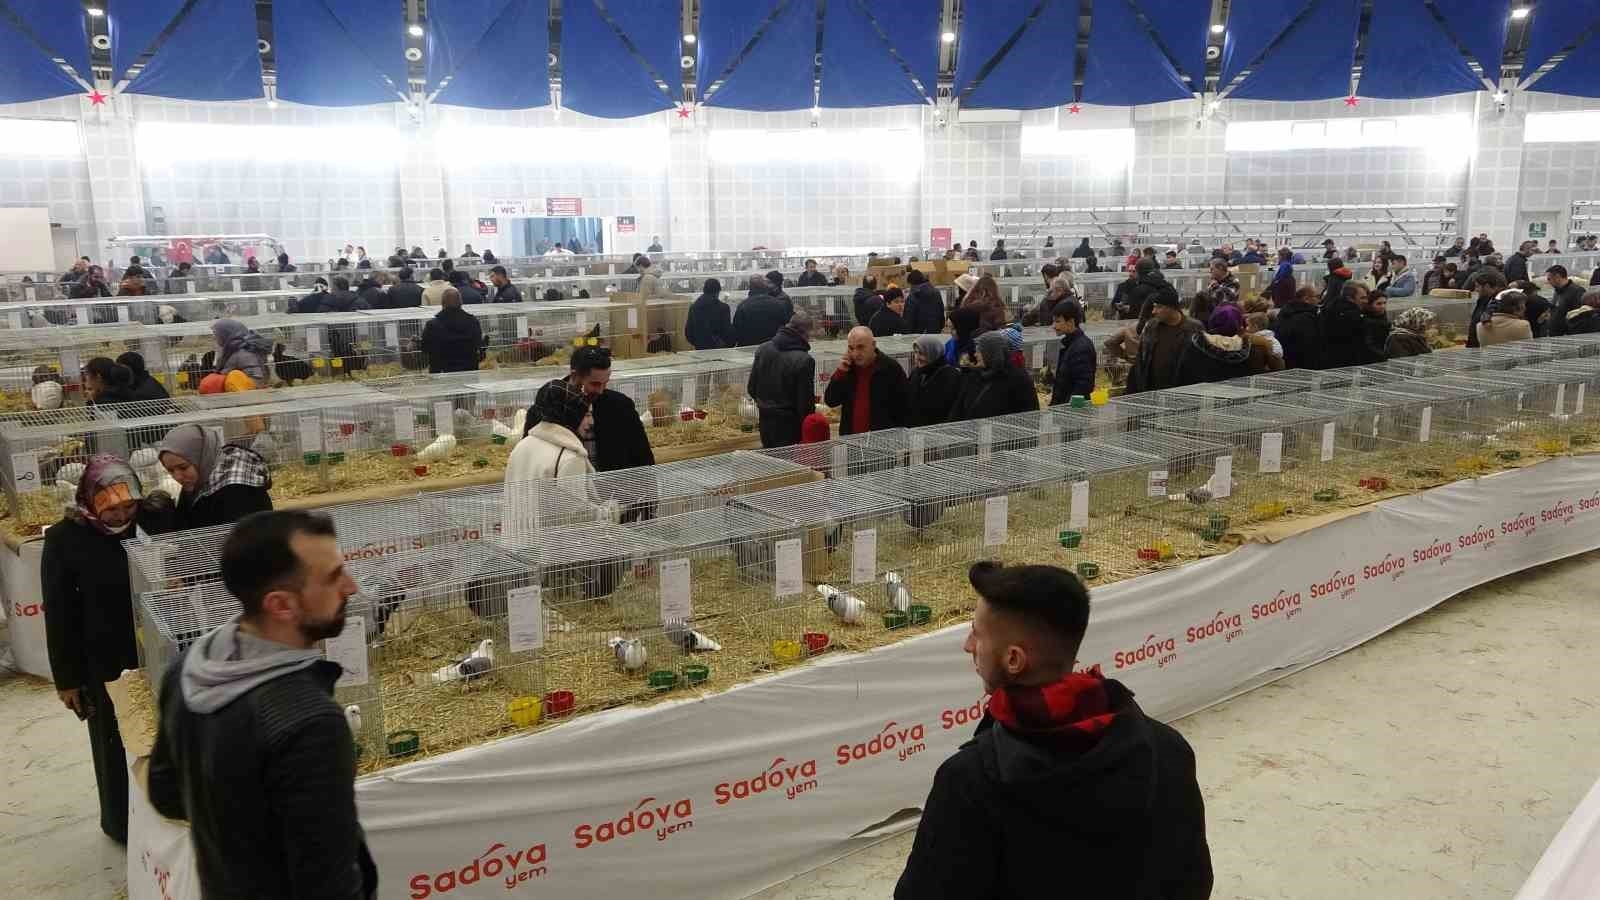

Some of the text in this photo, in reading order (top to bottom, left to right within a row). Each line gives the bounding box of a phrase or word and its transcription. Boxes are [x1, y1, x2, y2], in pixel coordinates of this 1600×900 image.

[898, 742, 926, 762] yem
[786, 779, 819, 801] yem
[656, 820, 694, 841] yem
[504, 865, 547, 889] yem
